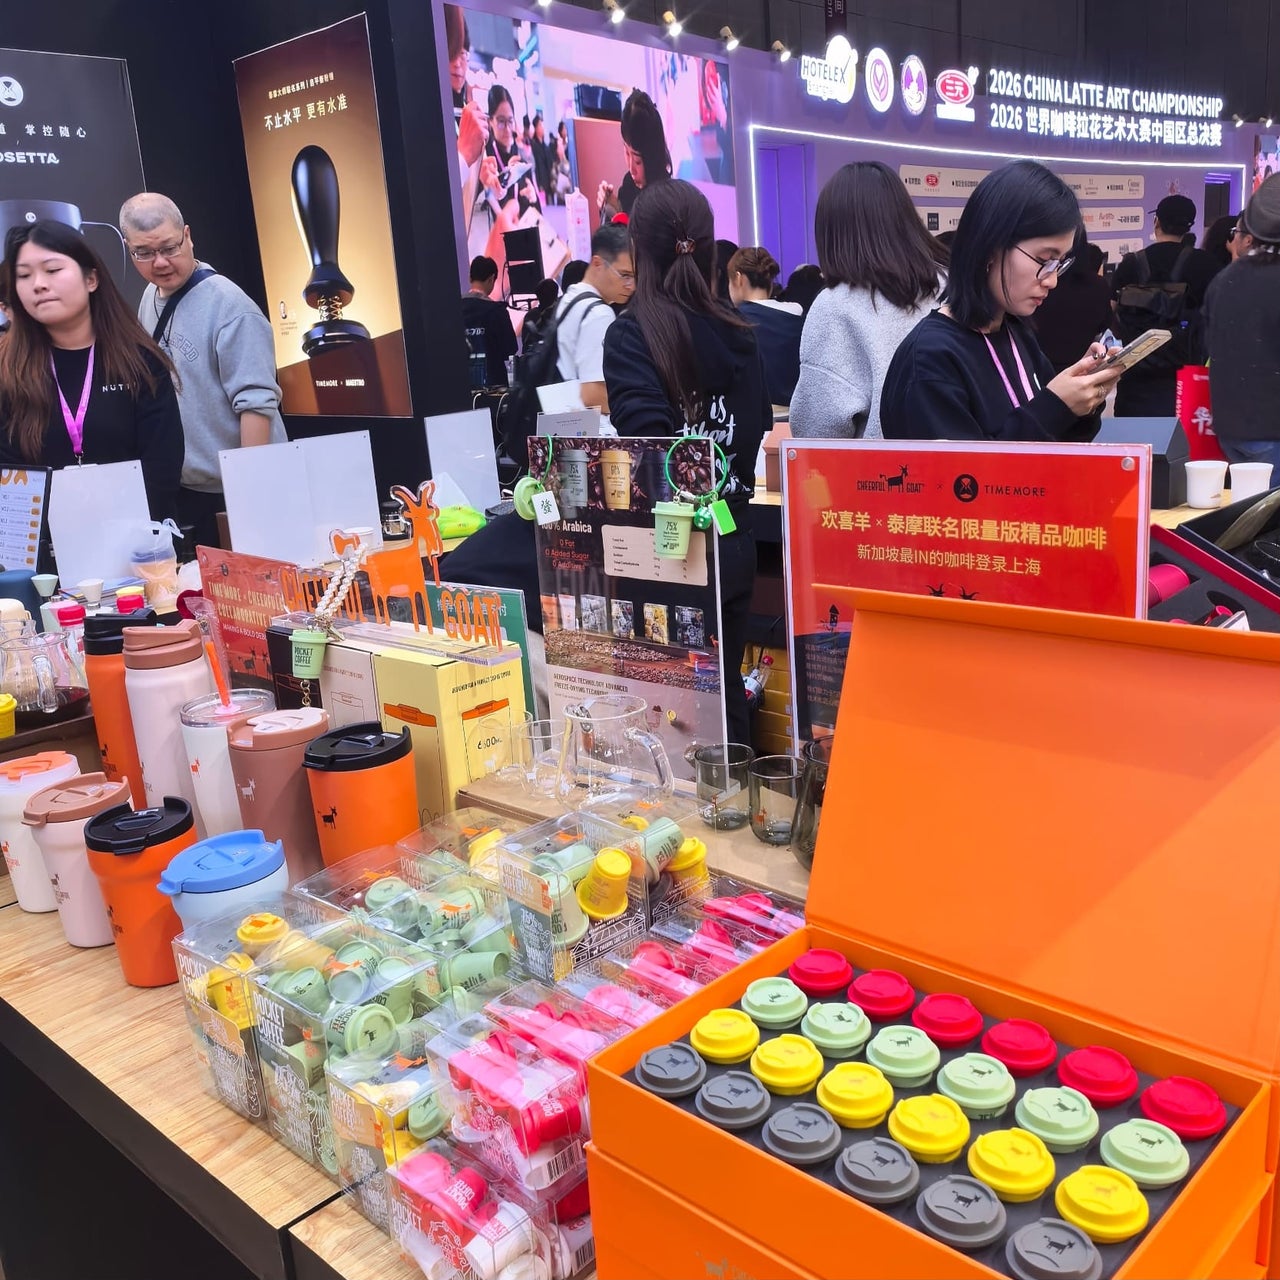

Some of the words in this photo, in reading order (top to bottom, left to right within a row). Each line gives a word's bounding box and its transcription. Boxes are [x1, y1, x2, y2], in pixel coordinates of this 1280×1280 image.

[802, 59, 847, 84] HOTELEX
[989, 68, 1022, 95] 2026
[1024, 70, 1063, 102] CHINA
[1063, 75, 1104, 106] LATTE
[1106, 87, 1131, 110] ART
[1131, 89, 1224, 119] CHAMPIONSHIP
[264, 106, 302, 131] 不止水平
[306, 93, 348, 120] 更有水准
[990, 102, 1023, 131] 2026
[1026, 106, 1223, 148] 世界咖啡拉花艺术大赛中国区总决赛
[25, 124, 87, 138] 掌控随心
[709, 395, 727, 423] is
[856, 479, 886, 492] CHEERFUL
[562, 520, 593, 533] Arabica
[821, 509, 871, 532] 欢喜羊
[887, 514, 1107, 550] 泰摩联名限量版精品咖啡
[857, 544, 1041, 577] 新加坡最IN的咖啡登录上海
[293, 646, 314, 657] POCKET
[253, 989, 285, 1021] POCKET
[257, 1013, 285, 1046] COFFEE
